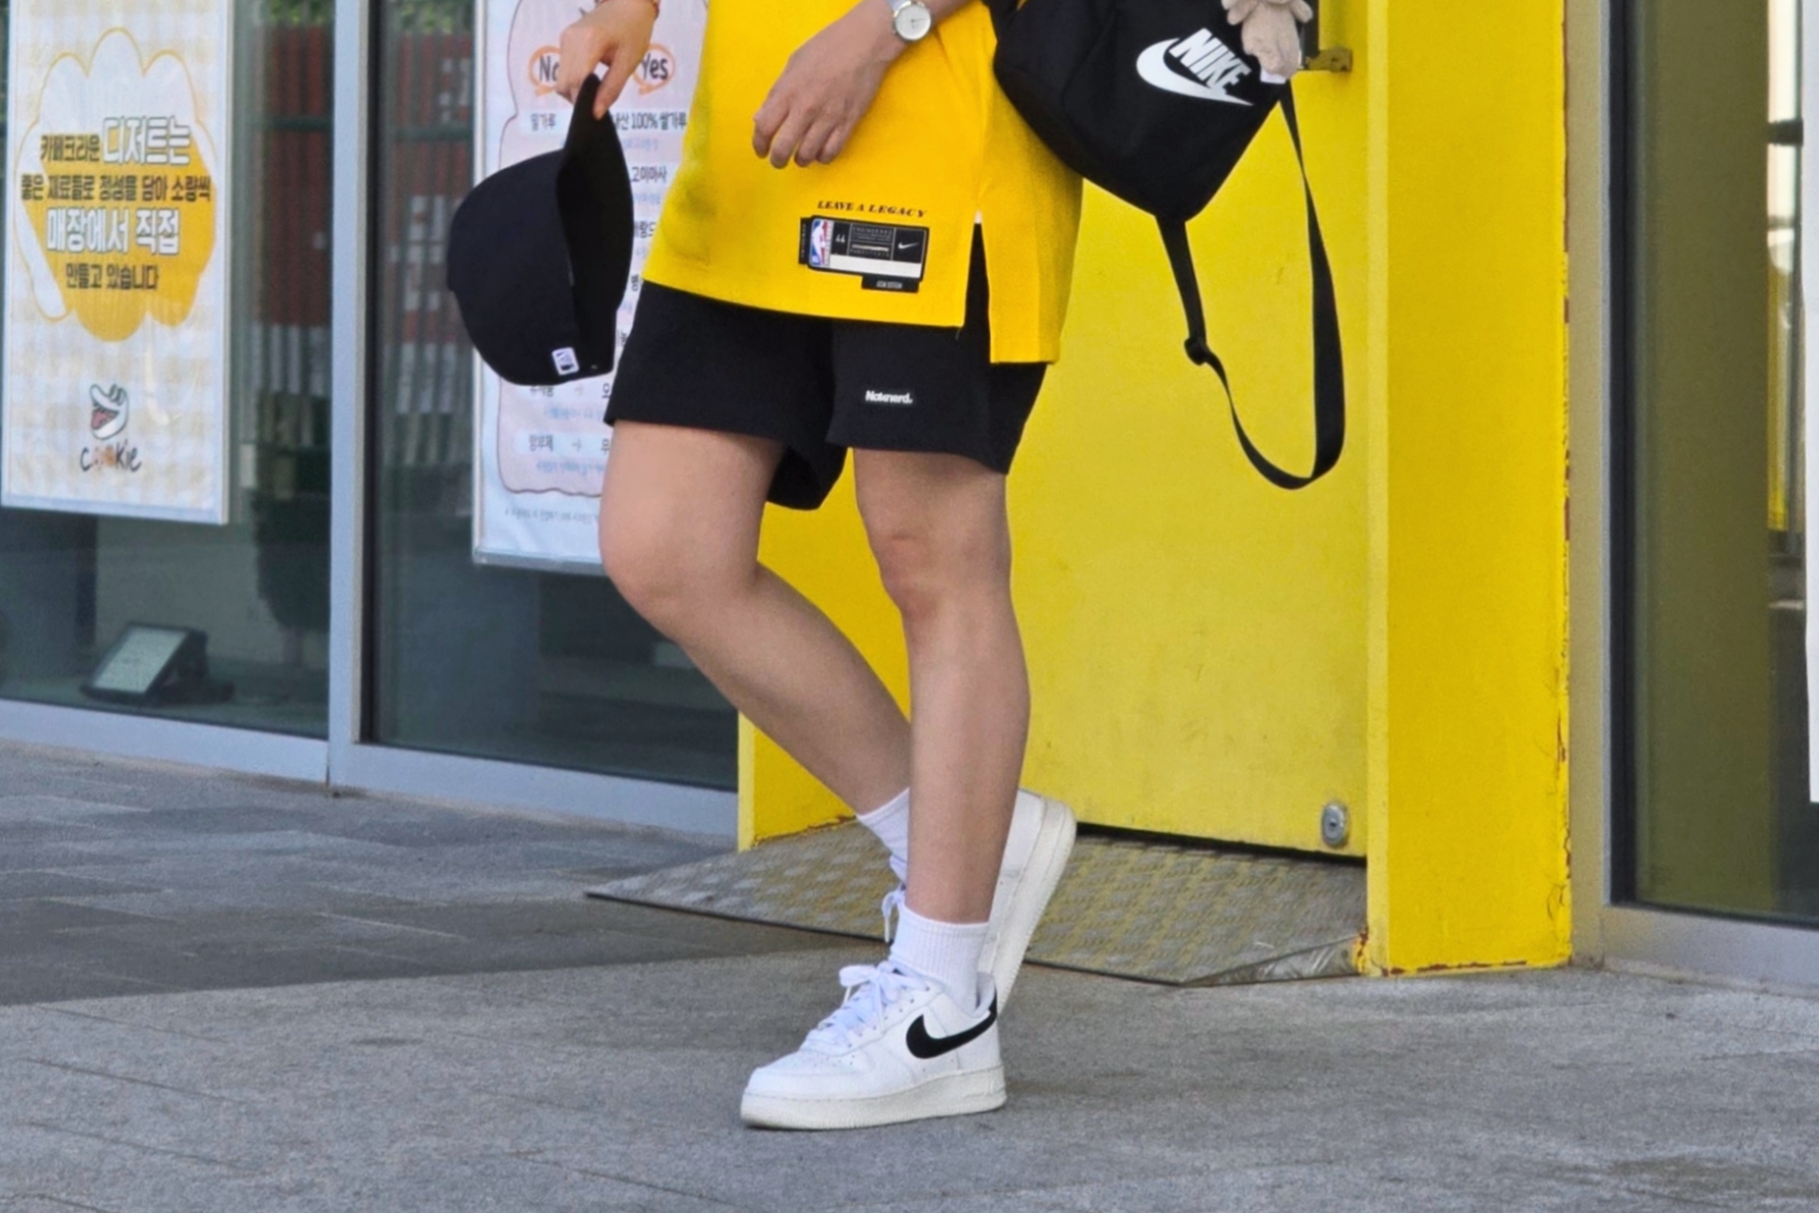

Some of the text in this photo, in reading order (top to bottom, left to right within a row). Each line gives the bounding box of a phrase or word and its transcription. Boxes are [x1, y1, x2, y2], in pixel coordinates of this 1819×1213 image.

[640, 52, 669, 81] Yes
[1169, 27, 1252, 96] NIKE
[529, 112, 557, 132] 밀가루
[631, 111, 658, 129] 100%
[660, 111, 687, 131] 쌀가루
[40, 114, 191, 166] 카페크라운 디저트는
[142, 174, 168, 201] 담아
[817, 199, 927, 219] LEAVE A LEGACY
[46, 206, 180, 256] 매장에서 직접
[65, 262, 160, 291] 만들고 있습니다
